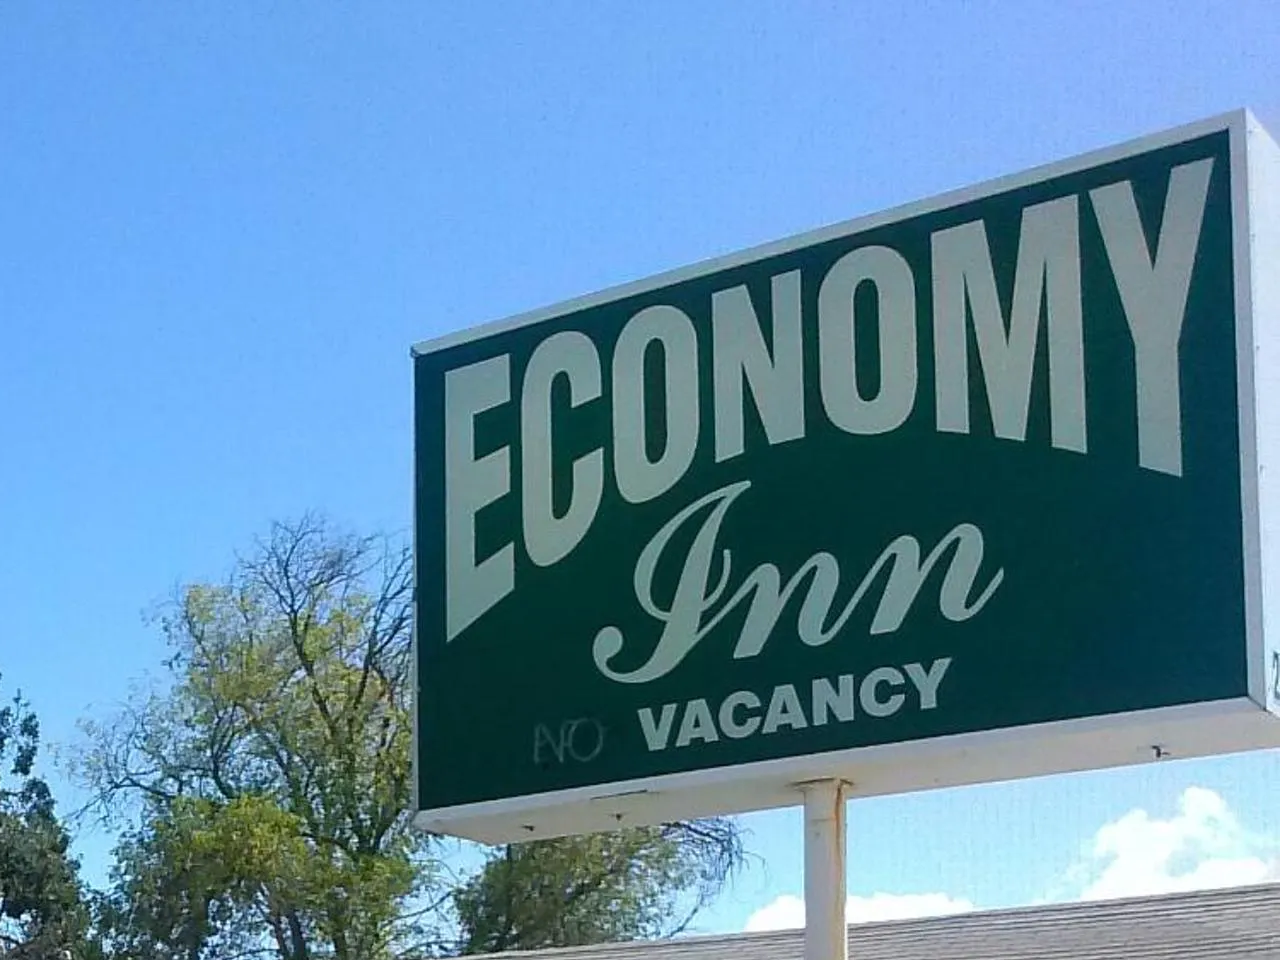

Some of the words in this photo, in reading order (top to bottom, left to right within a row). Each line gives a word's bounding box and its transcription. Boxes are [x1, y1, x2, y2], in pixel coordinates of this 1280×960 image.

[445, 158, 1214, 643] ECONOMY
[593, 481, 1004, 683] Inn
[532, 717, 605, 763] NO
[637, 658, 953, 751] VACANCY
